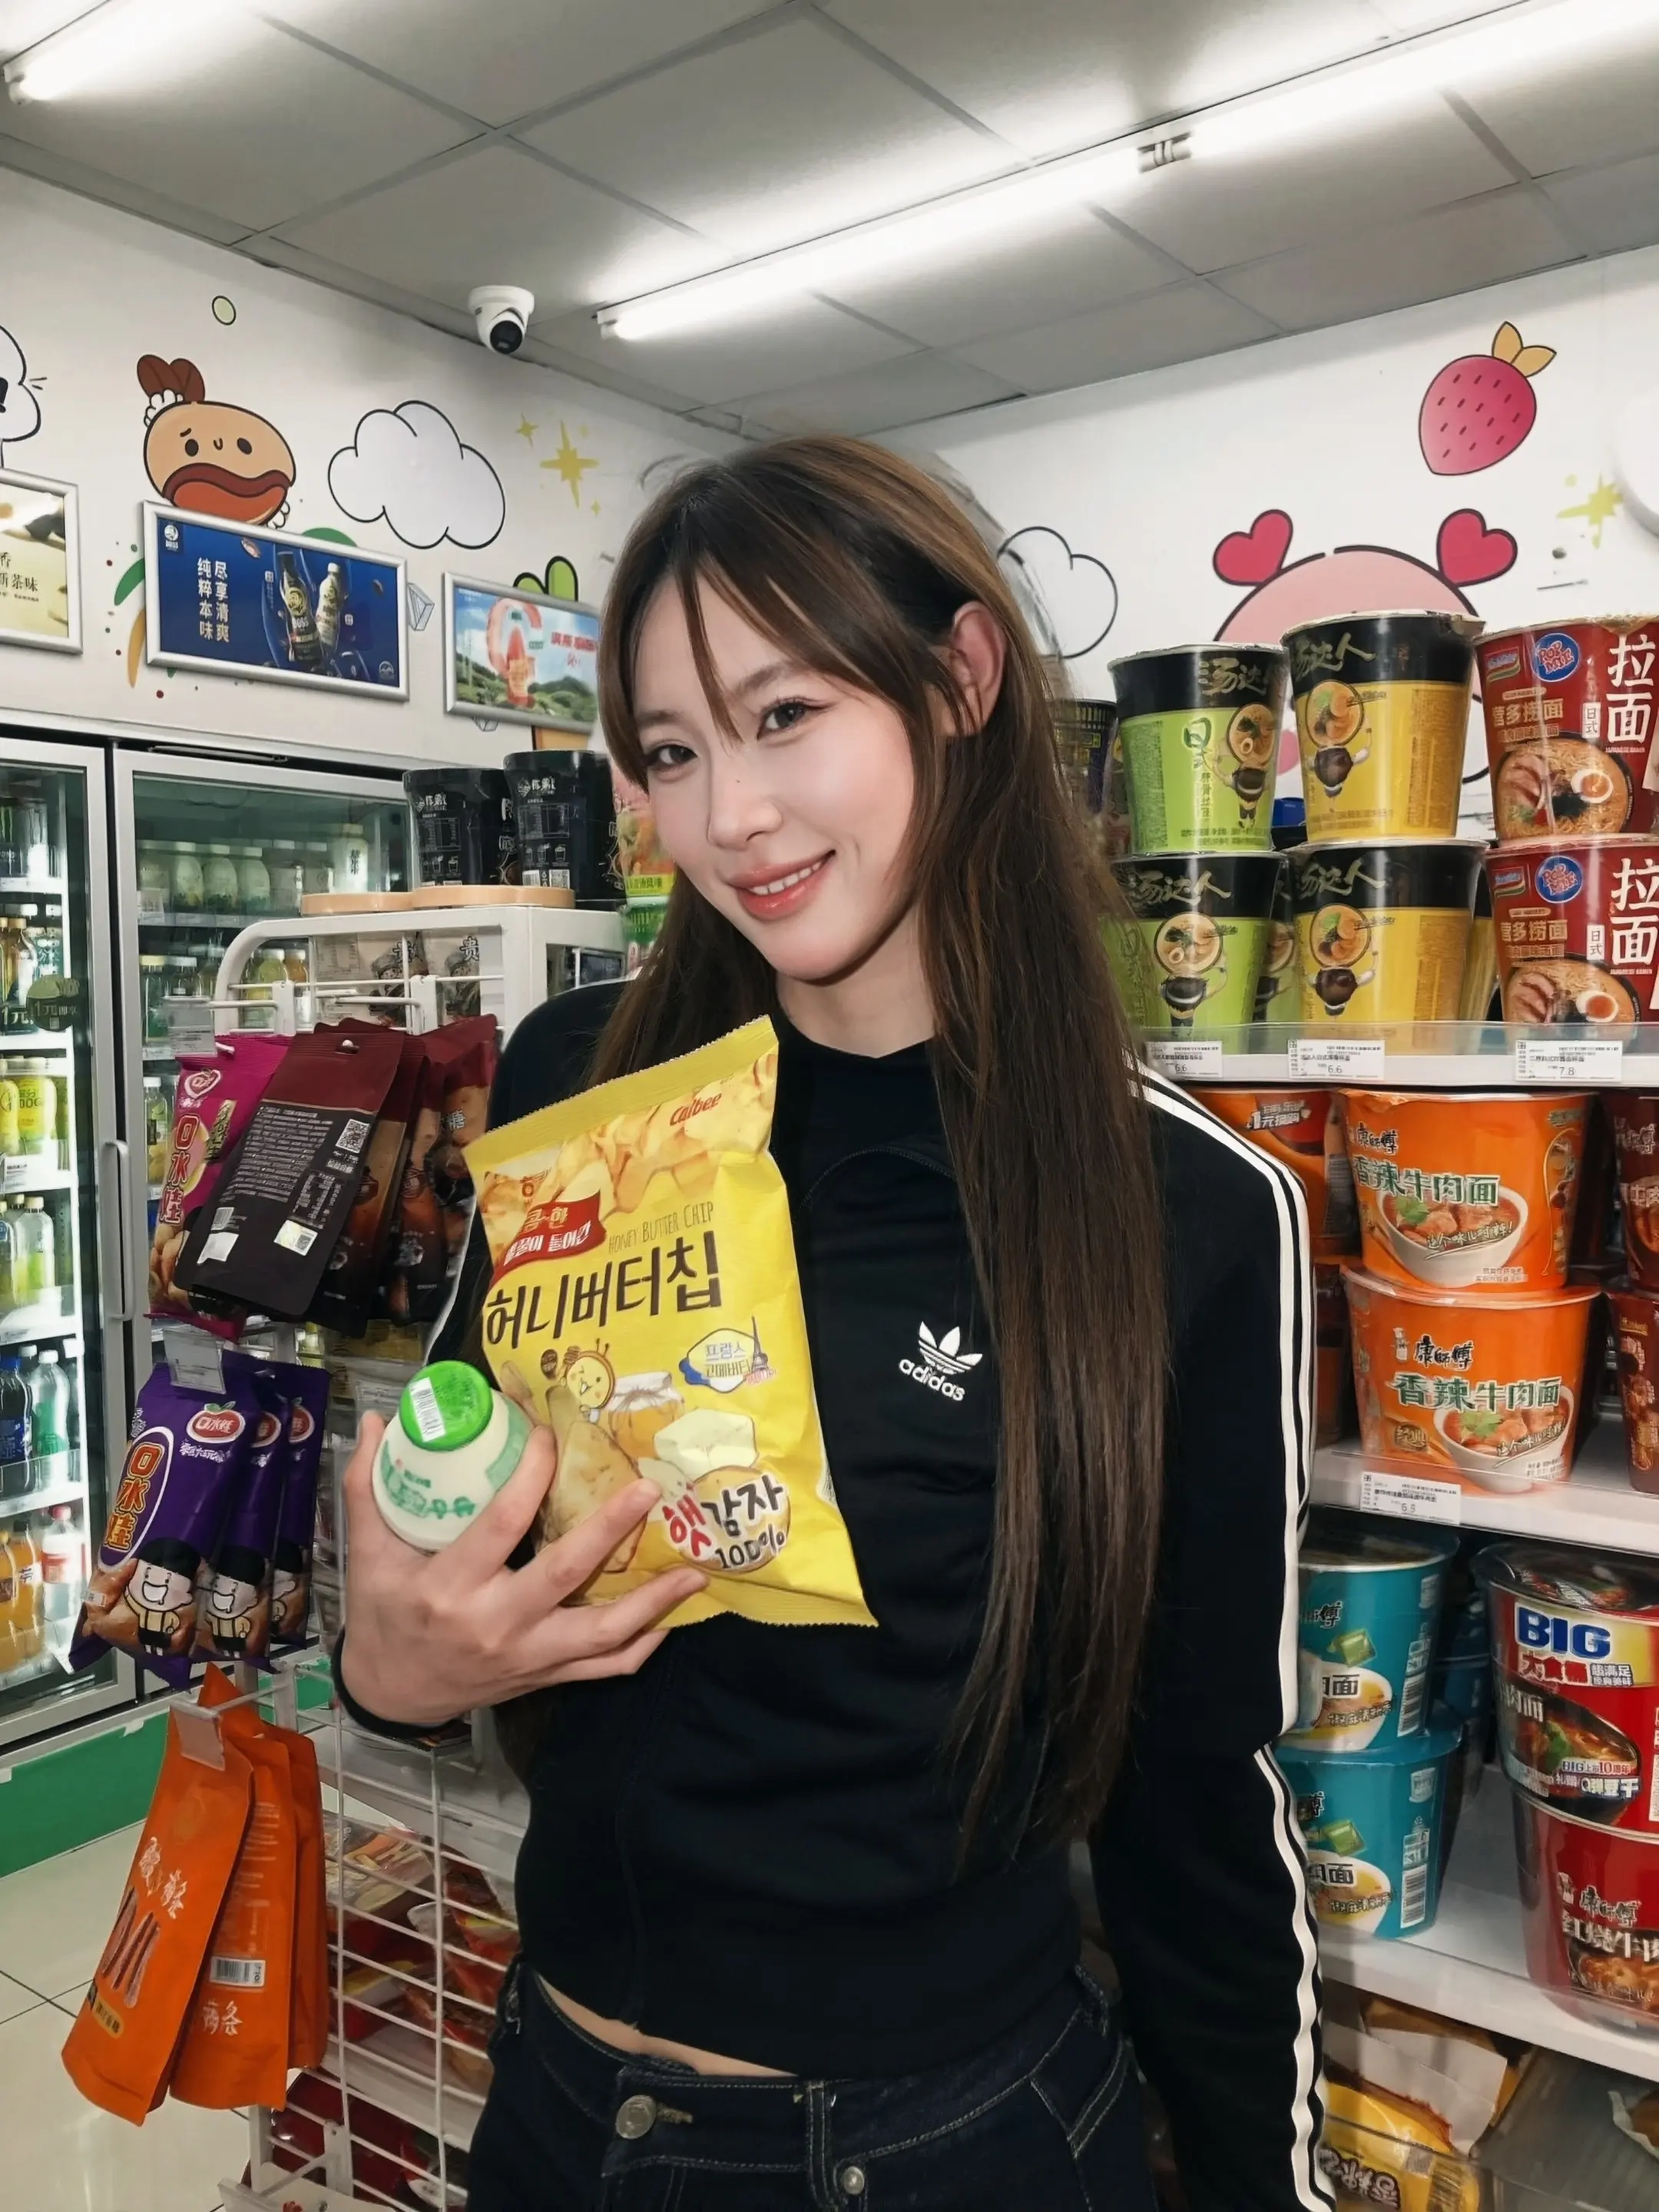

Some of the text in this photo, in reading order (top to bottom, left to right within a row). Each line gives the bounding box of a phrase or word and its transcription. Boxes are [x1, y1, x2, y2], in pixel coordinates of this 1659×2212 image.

[197, 557, 214, 641] 纯粹本味
[214, 560, 230, 644] 尽享清爽
[1198, 657, 1275, 696] 汤达
[1606, 634, 1656, 744] 拉面
[1584, 707, 1598, 733] 日式
[1610, 857, 1659, 965] 拉面
[1590, 929, 1604, 955] 日式
[1327, 1065, 1343, 1074] 6.6
[1558, 1066, 1575, 1076] 7.8
[669, 1092, 723, 1126] Calbee
[159, 1113, 201, 1225] 口水娃
[1352, 1154, 1501, 1208] 香辣牛肉面
[608, 1201, 714, 1254] HONEY BUTTER CHIP
[485, 1229, 724, 1349] 허니버터칩
[705, 1341, 747, 1363] 프랑스
[899, 1359, 965, 1402] adidas
[1391, 1371, 1562, 1414] 香辣牛肉面
[194, 1416, 233, 1434] 口水娃
[103, 1441, 166, 1552] 口水娃
[714, 1523, 786, 1570] 100%
[1517, 1605, 1611, 1660] BIG
